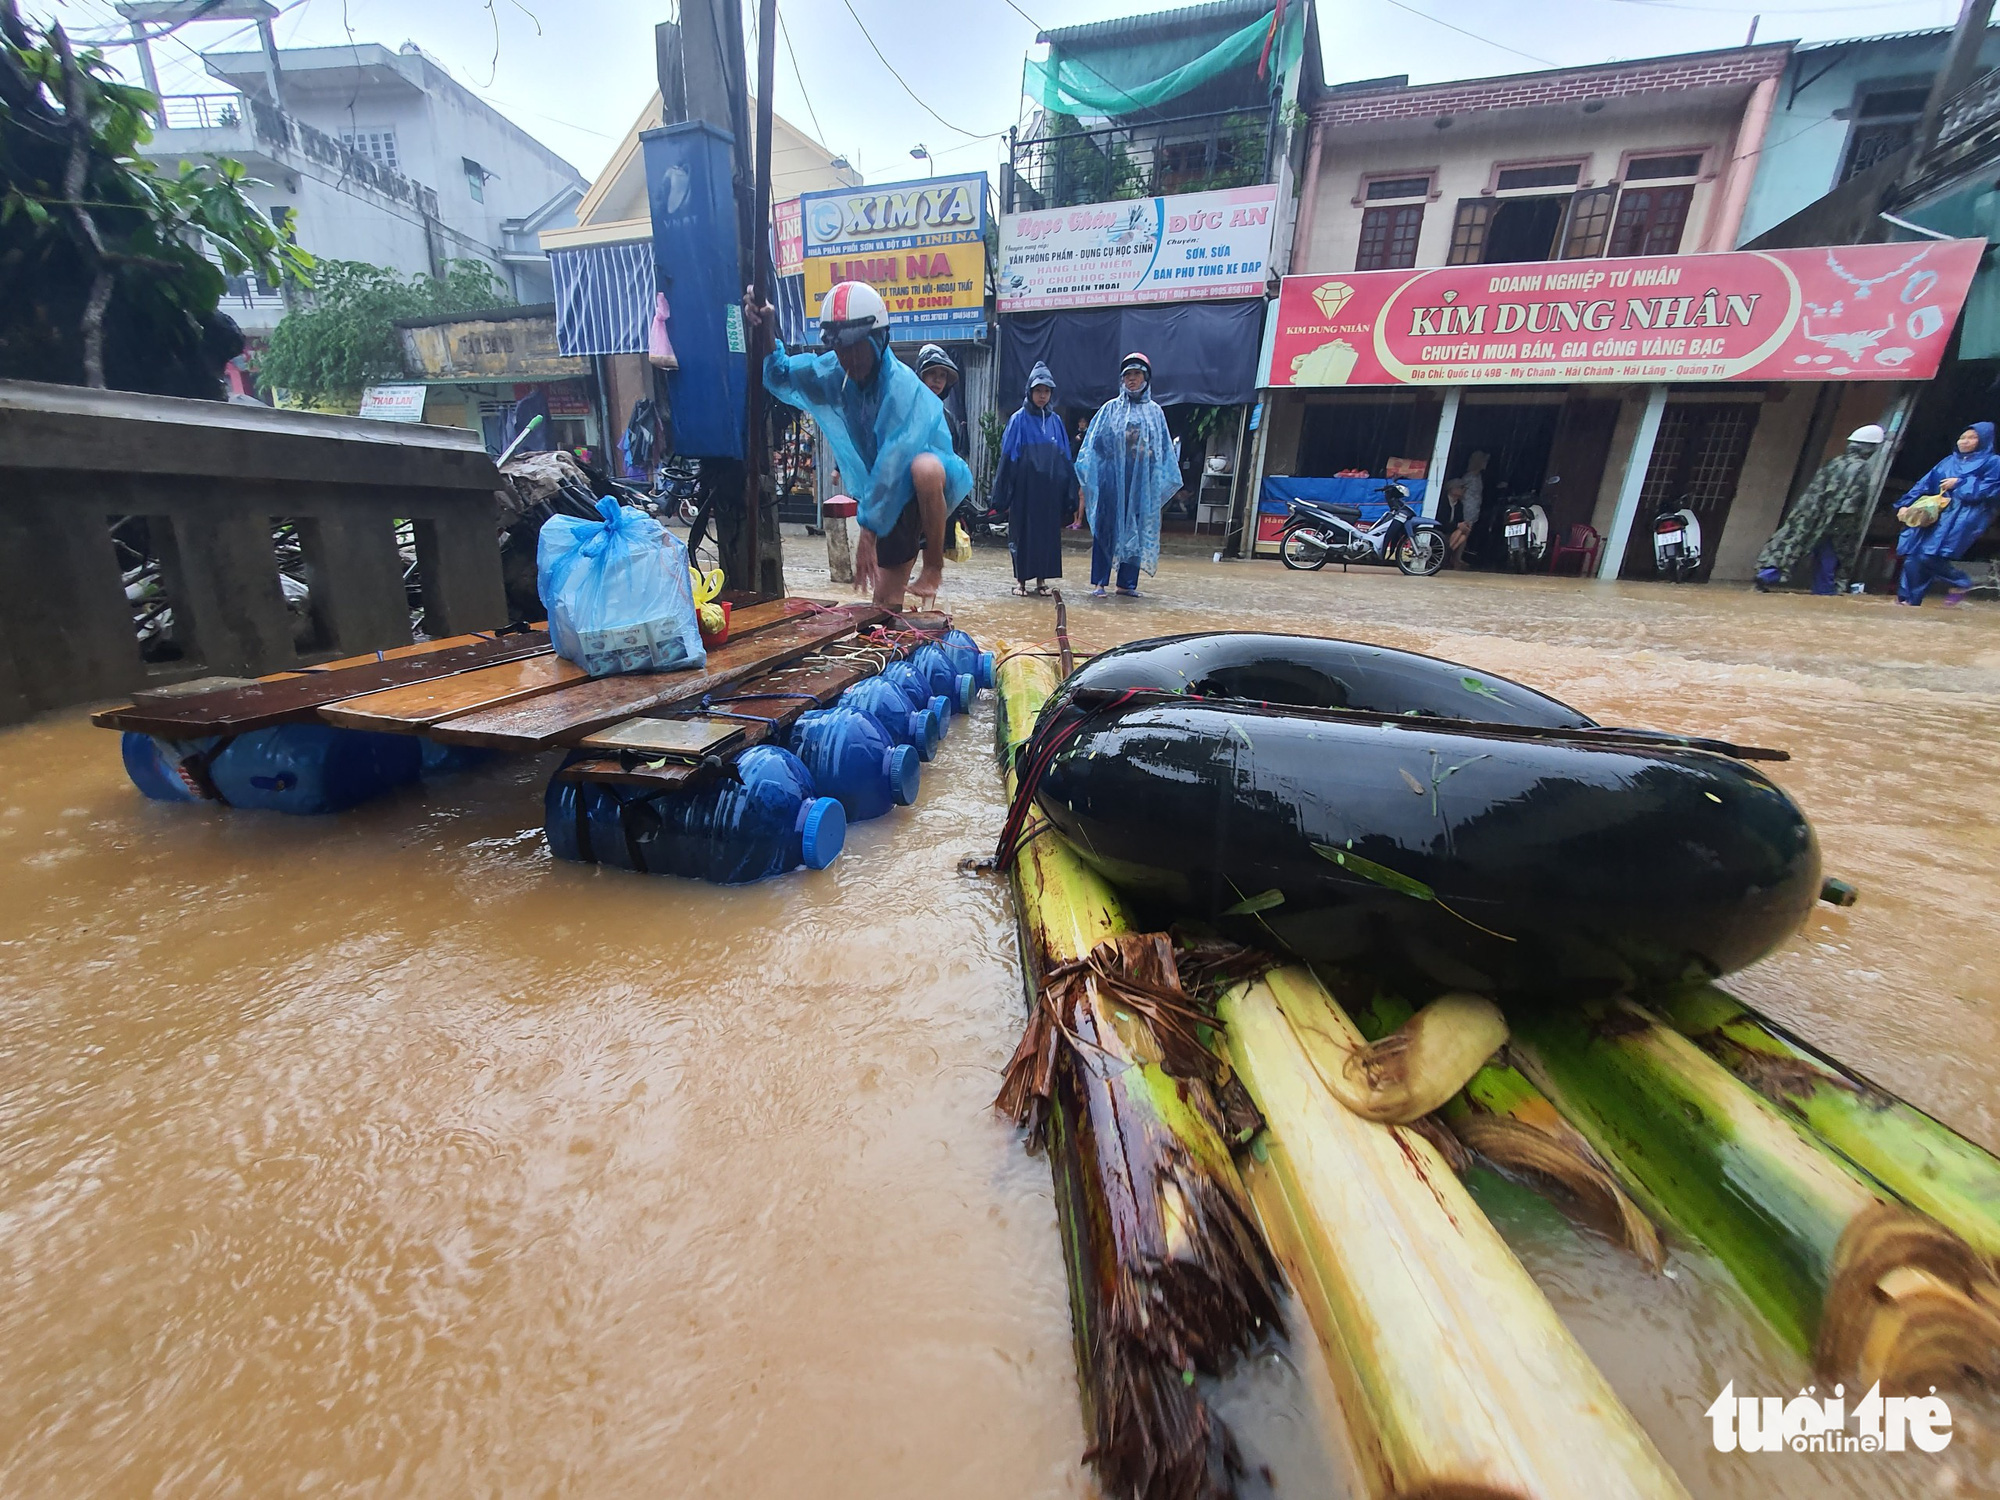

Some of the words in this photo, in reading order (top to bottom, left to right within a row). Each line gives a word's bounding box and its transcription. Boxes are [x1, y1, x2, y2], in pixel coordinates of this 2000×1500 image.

[845, 187, 976, 235] XIMYA
[1168, 210, 1223, 234] ĐỨC
[1229, 207, 1269, 227] AN
[777, 217, 801, 242] LINH
[916, 233, 953, 246] LINH
[956, 230, 978, 242] NA
[781, 243, 798, 264] NA
[1009, 253, 1024, 265] VĂN
[1025, 251, 1050, 263] PHÒNG
[1051, 248, 1074, 260] PHẨM
[1080, 248, 1101, 260] DỤNG
[1103, 247, 1114, 259] CỤ
[1115, 245, 1131, 257] HỌC
[1133, 242, 1153, 254] SINH
[1210, 244, 1231, 258] SỬA
[830, 257, 898, 285] LINH
[906, 253, 954, 279] NA
[1153, 266, 1173, 280] BÁN
[1175, 265, 1195, 280] PHỤ
[1198, 263, 1224, 277] TÙNG
[1226, 262, 1239, 274] XE
[1241, 261, 1262, 275] ĐẠP
[1488, 275, 1543, 294] DOANH
[1544, 269, 1605, 293] NGHIỆP
[1609, 268, 1632, 289] TƯ
[1632, 265, 1682, 287] NHÂN
[889, 285, 909, 297] TRANG
[896, 297, 914, 310] VỆ
[917, 295, 953, 308] SINH
[1492, 299, 1616, 335] DUNG
[1620, 287, 1762, 331] NHÂN
[1286, 325, 1307, 335] KIM
[1308, 325, 1338, 334] DUNG
[1339, 323, 1371, 333] NHÂN
[1421, 342, 1480, 362] CHUYÊN
[1482, 344, 1518, 361] MUA
[1520, 340, 1557, 360] BÁN,
[1561, 342, 1587, 358] GIA
[1592, 338, 1637, 357] CÔNG
[1641, 336, 1687, 356] VÀNG
[1688, 337, 1726, 359] BẠC
[1411, 369, 1426, 381] Địa
[1446, 367, 1469, 379] Quốc
[1471, 368, 1482, 379] Lộ
[1484, 369, 1503, 378] 49B
[1510, 368, 1525, 379] Mỹ
[1527, 367, 1556, 378] Chánh
[1565, 366, 1581, 377] Hải
[1583, 365, 1614, 377] Chánh
[1623, 364, 1640, 376] Hải
[1676, 362, 1708, 375] Quảng
[1711, 364, 1725, 377] Trị
